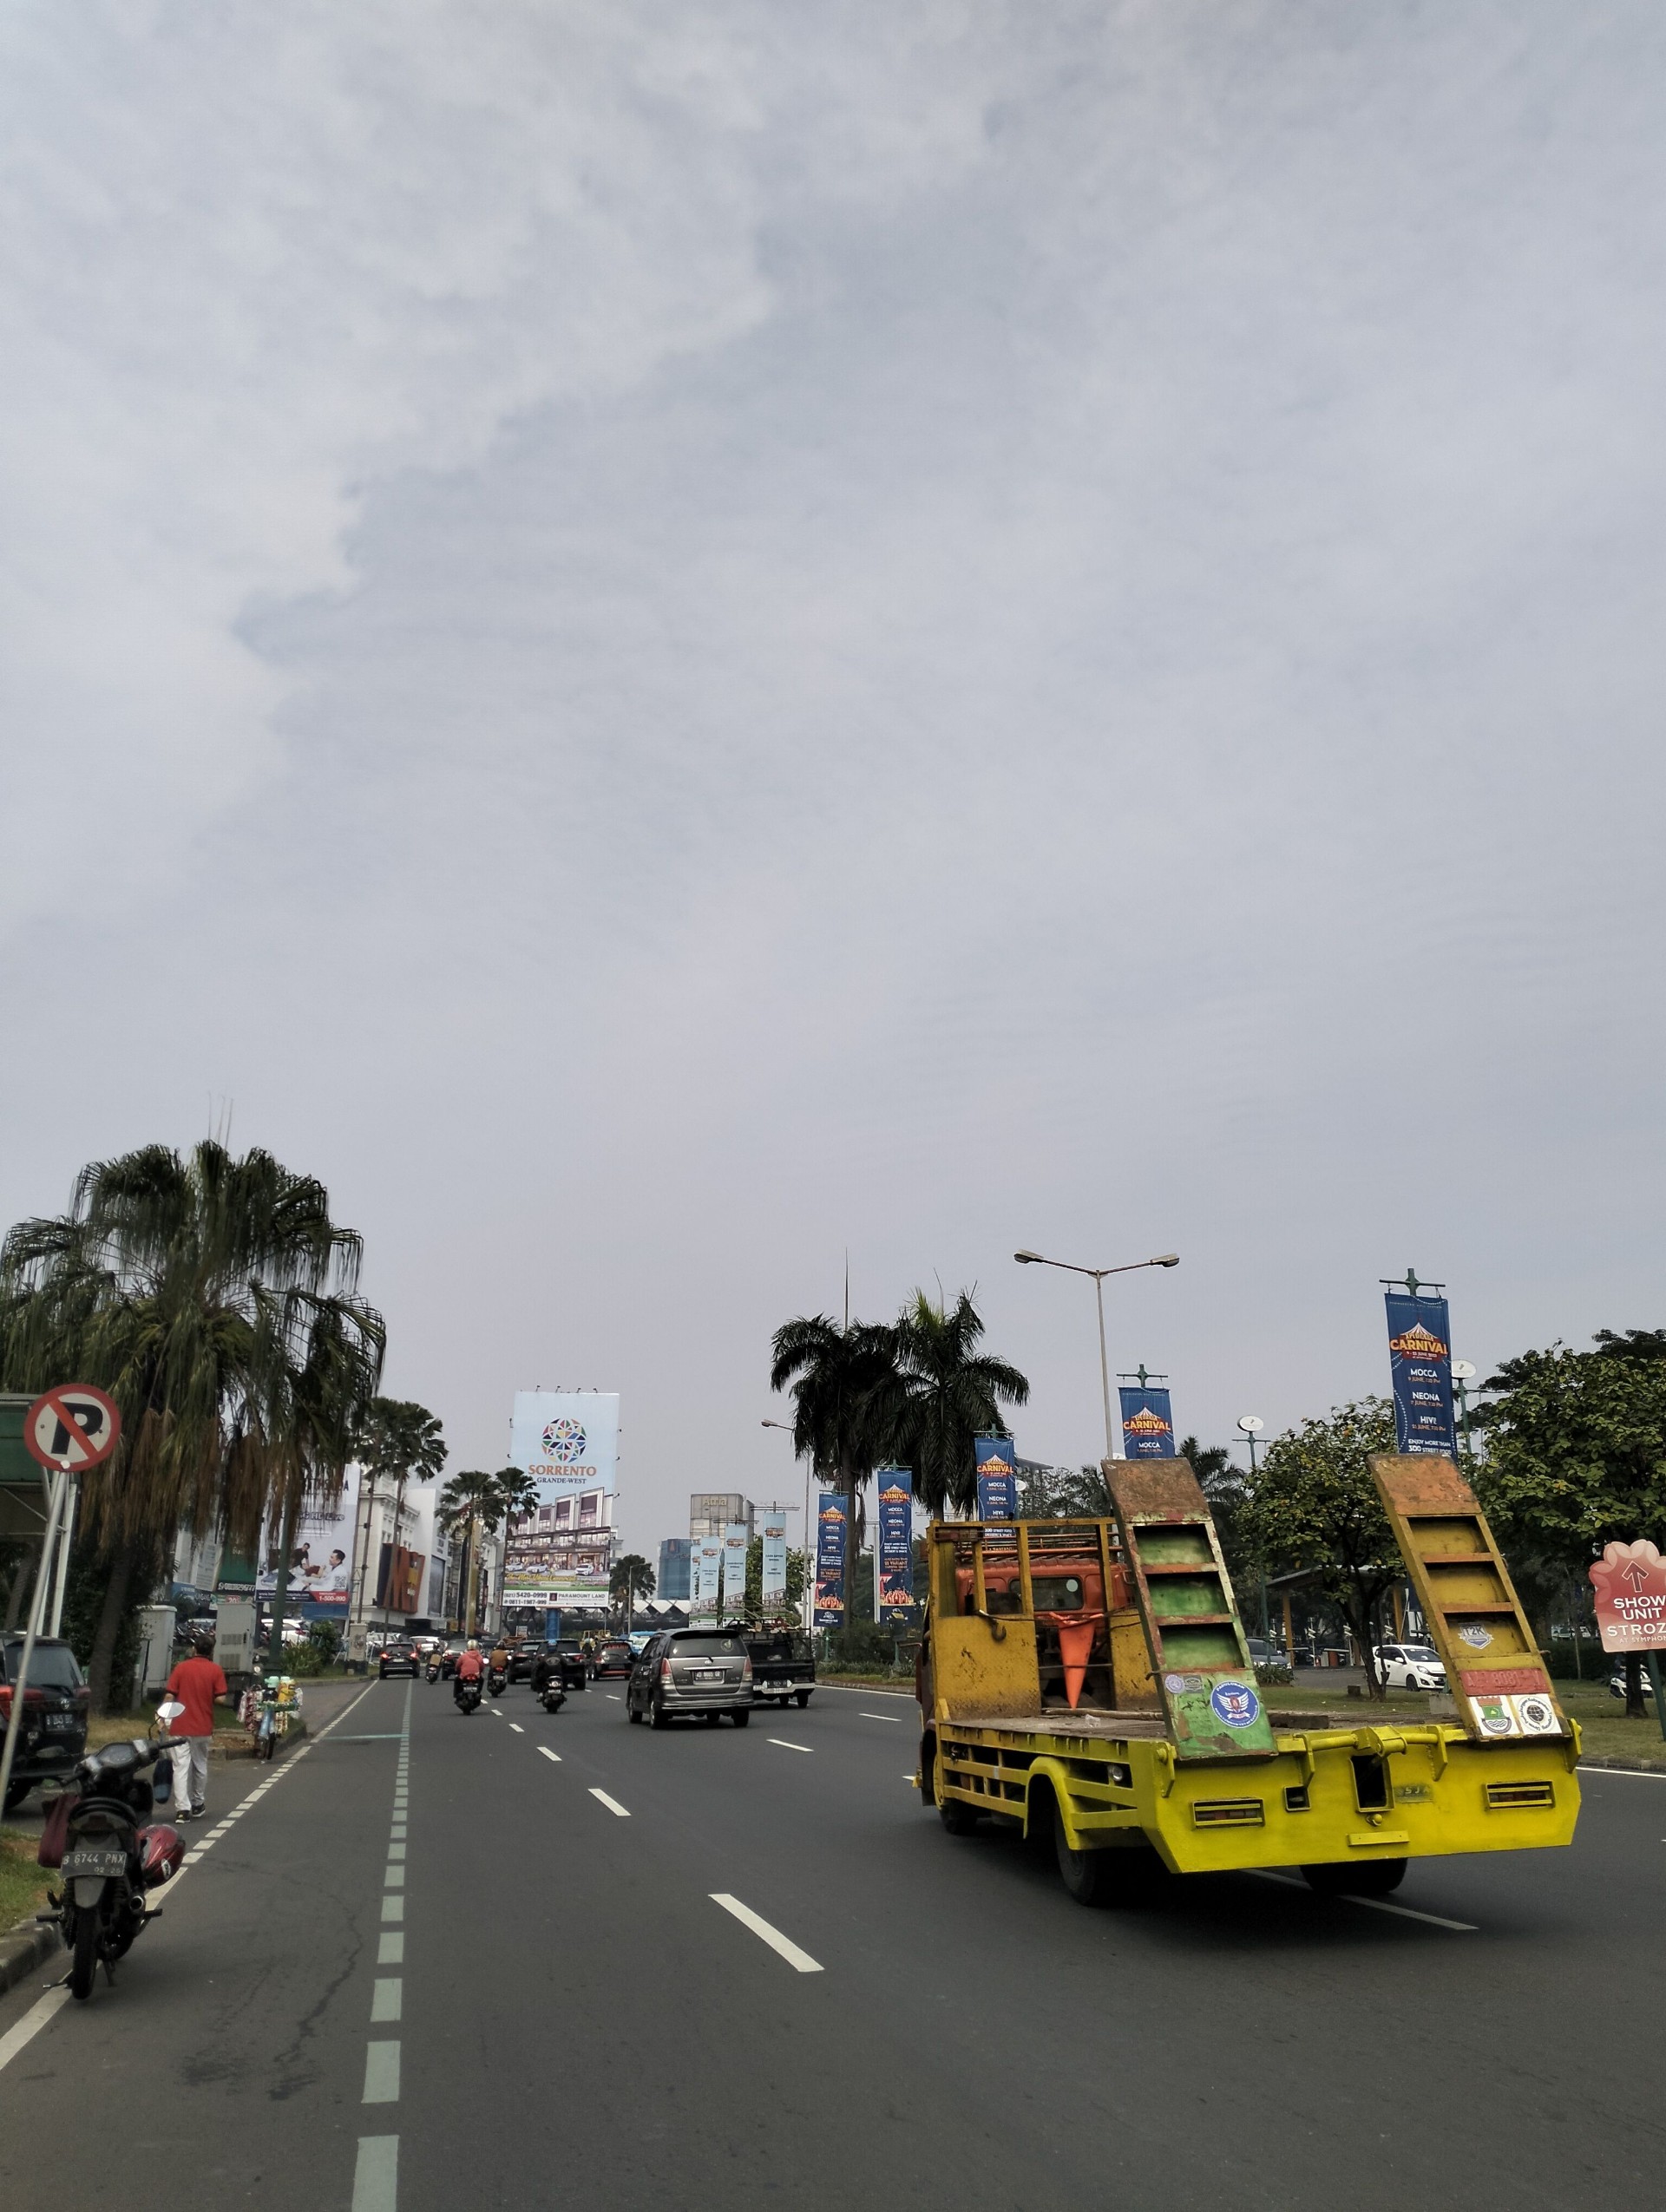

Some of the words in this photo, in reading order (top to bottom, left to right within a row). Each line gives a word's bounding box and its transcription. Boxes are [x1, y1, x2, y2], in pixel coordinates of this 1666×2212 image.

[1390, 1338, 1448, 1355] CARNIVAL
[1410, 1368, 1438, 1378] MOCCA
[1412, 1391, 1440, 1402] NEONA
[1124, 1420, 1171, 1431] CARNIVAL
[528, 1464, 597, 1476] SORRENTO
[977, 1464, 1014, 1474] CARNIVAL
[1613, 1595, 1666, 1609] SHOW
[1622, 1607, 1663, 1620] UNIT
[1607, 1622, 1666, 1637] STROZ
[62, 1855, 69, 1865] B
[75, 1853, 99, 1864] 6744
